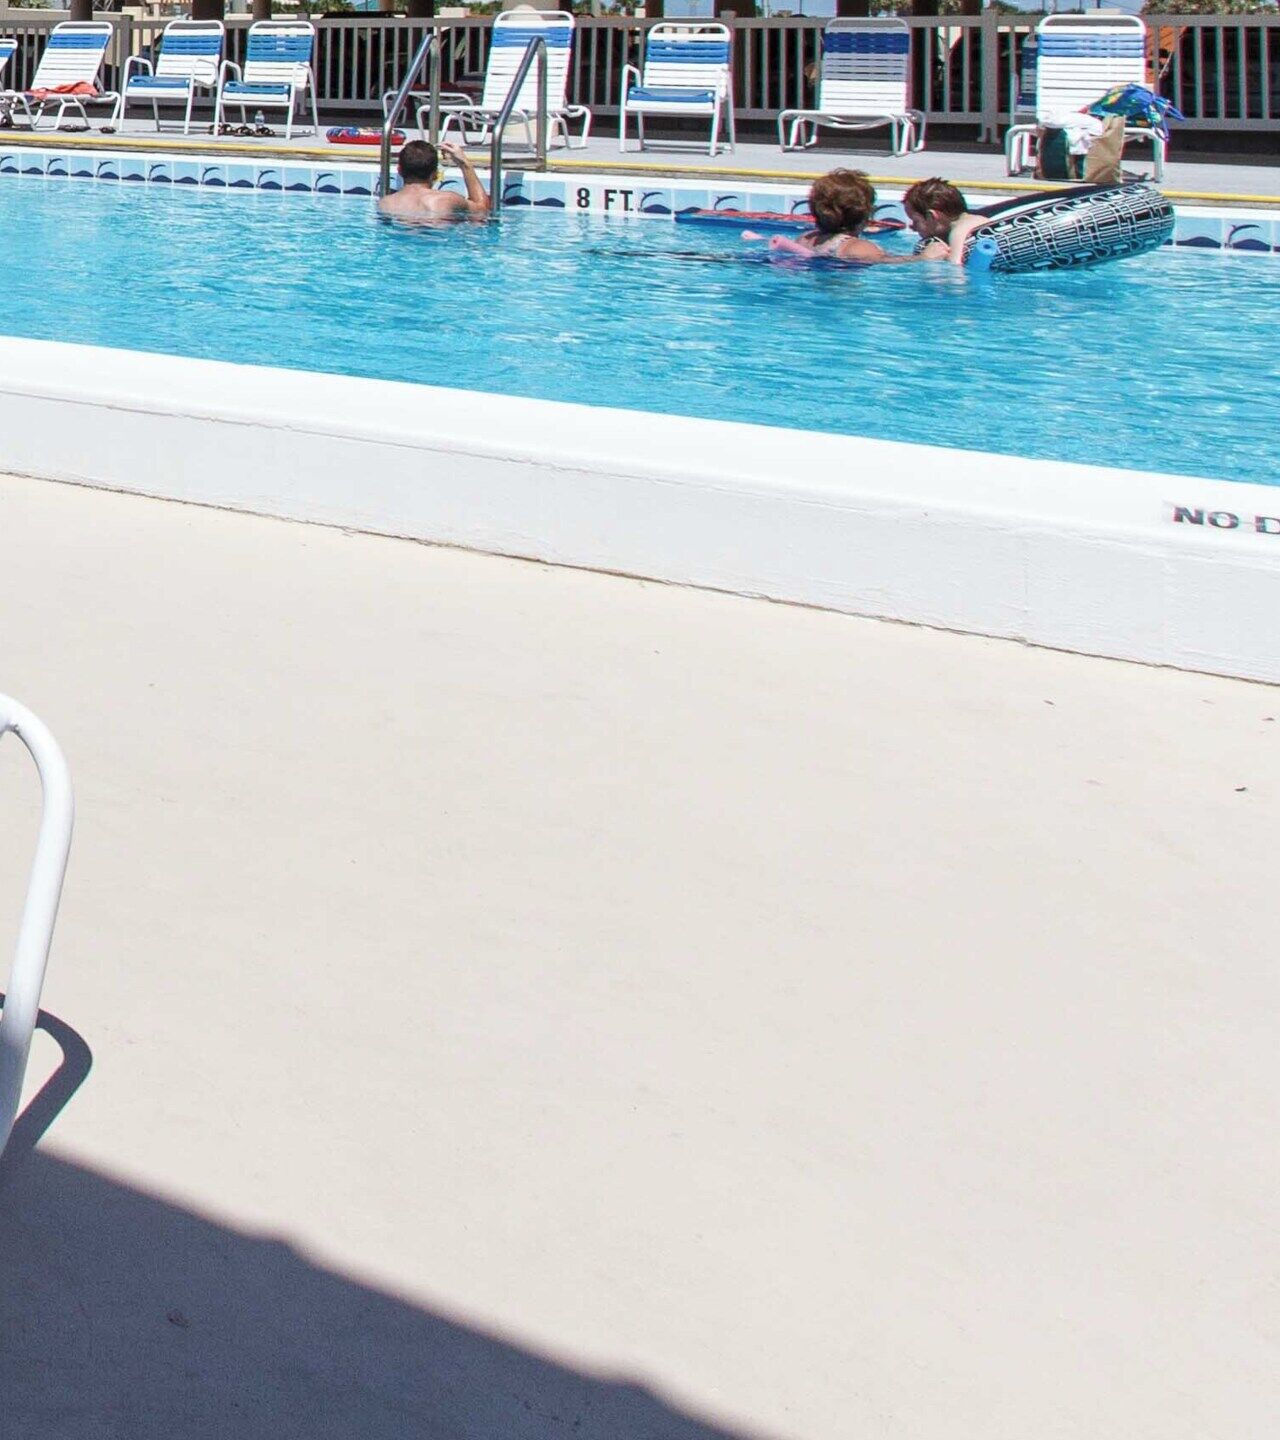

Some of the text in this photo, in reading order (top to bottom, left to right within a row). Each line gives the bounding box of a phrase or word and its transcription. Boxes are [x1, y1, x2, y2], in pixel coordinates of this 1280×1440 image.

[577, 188, 634, 211] 8 FT.
[1173, 506, 1239, 529] NO
